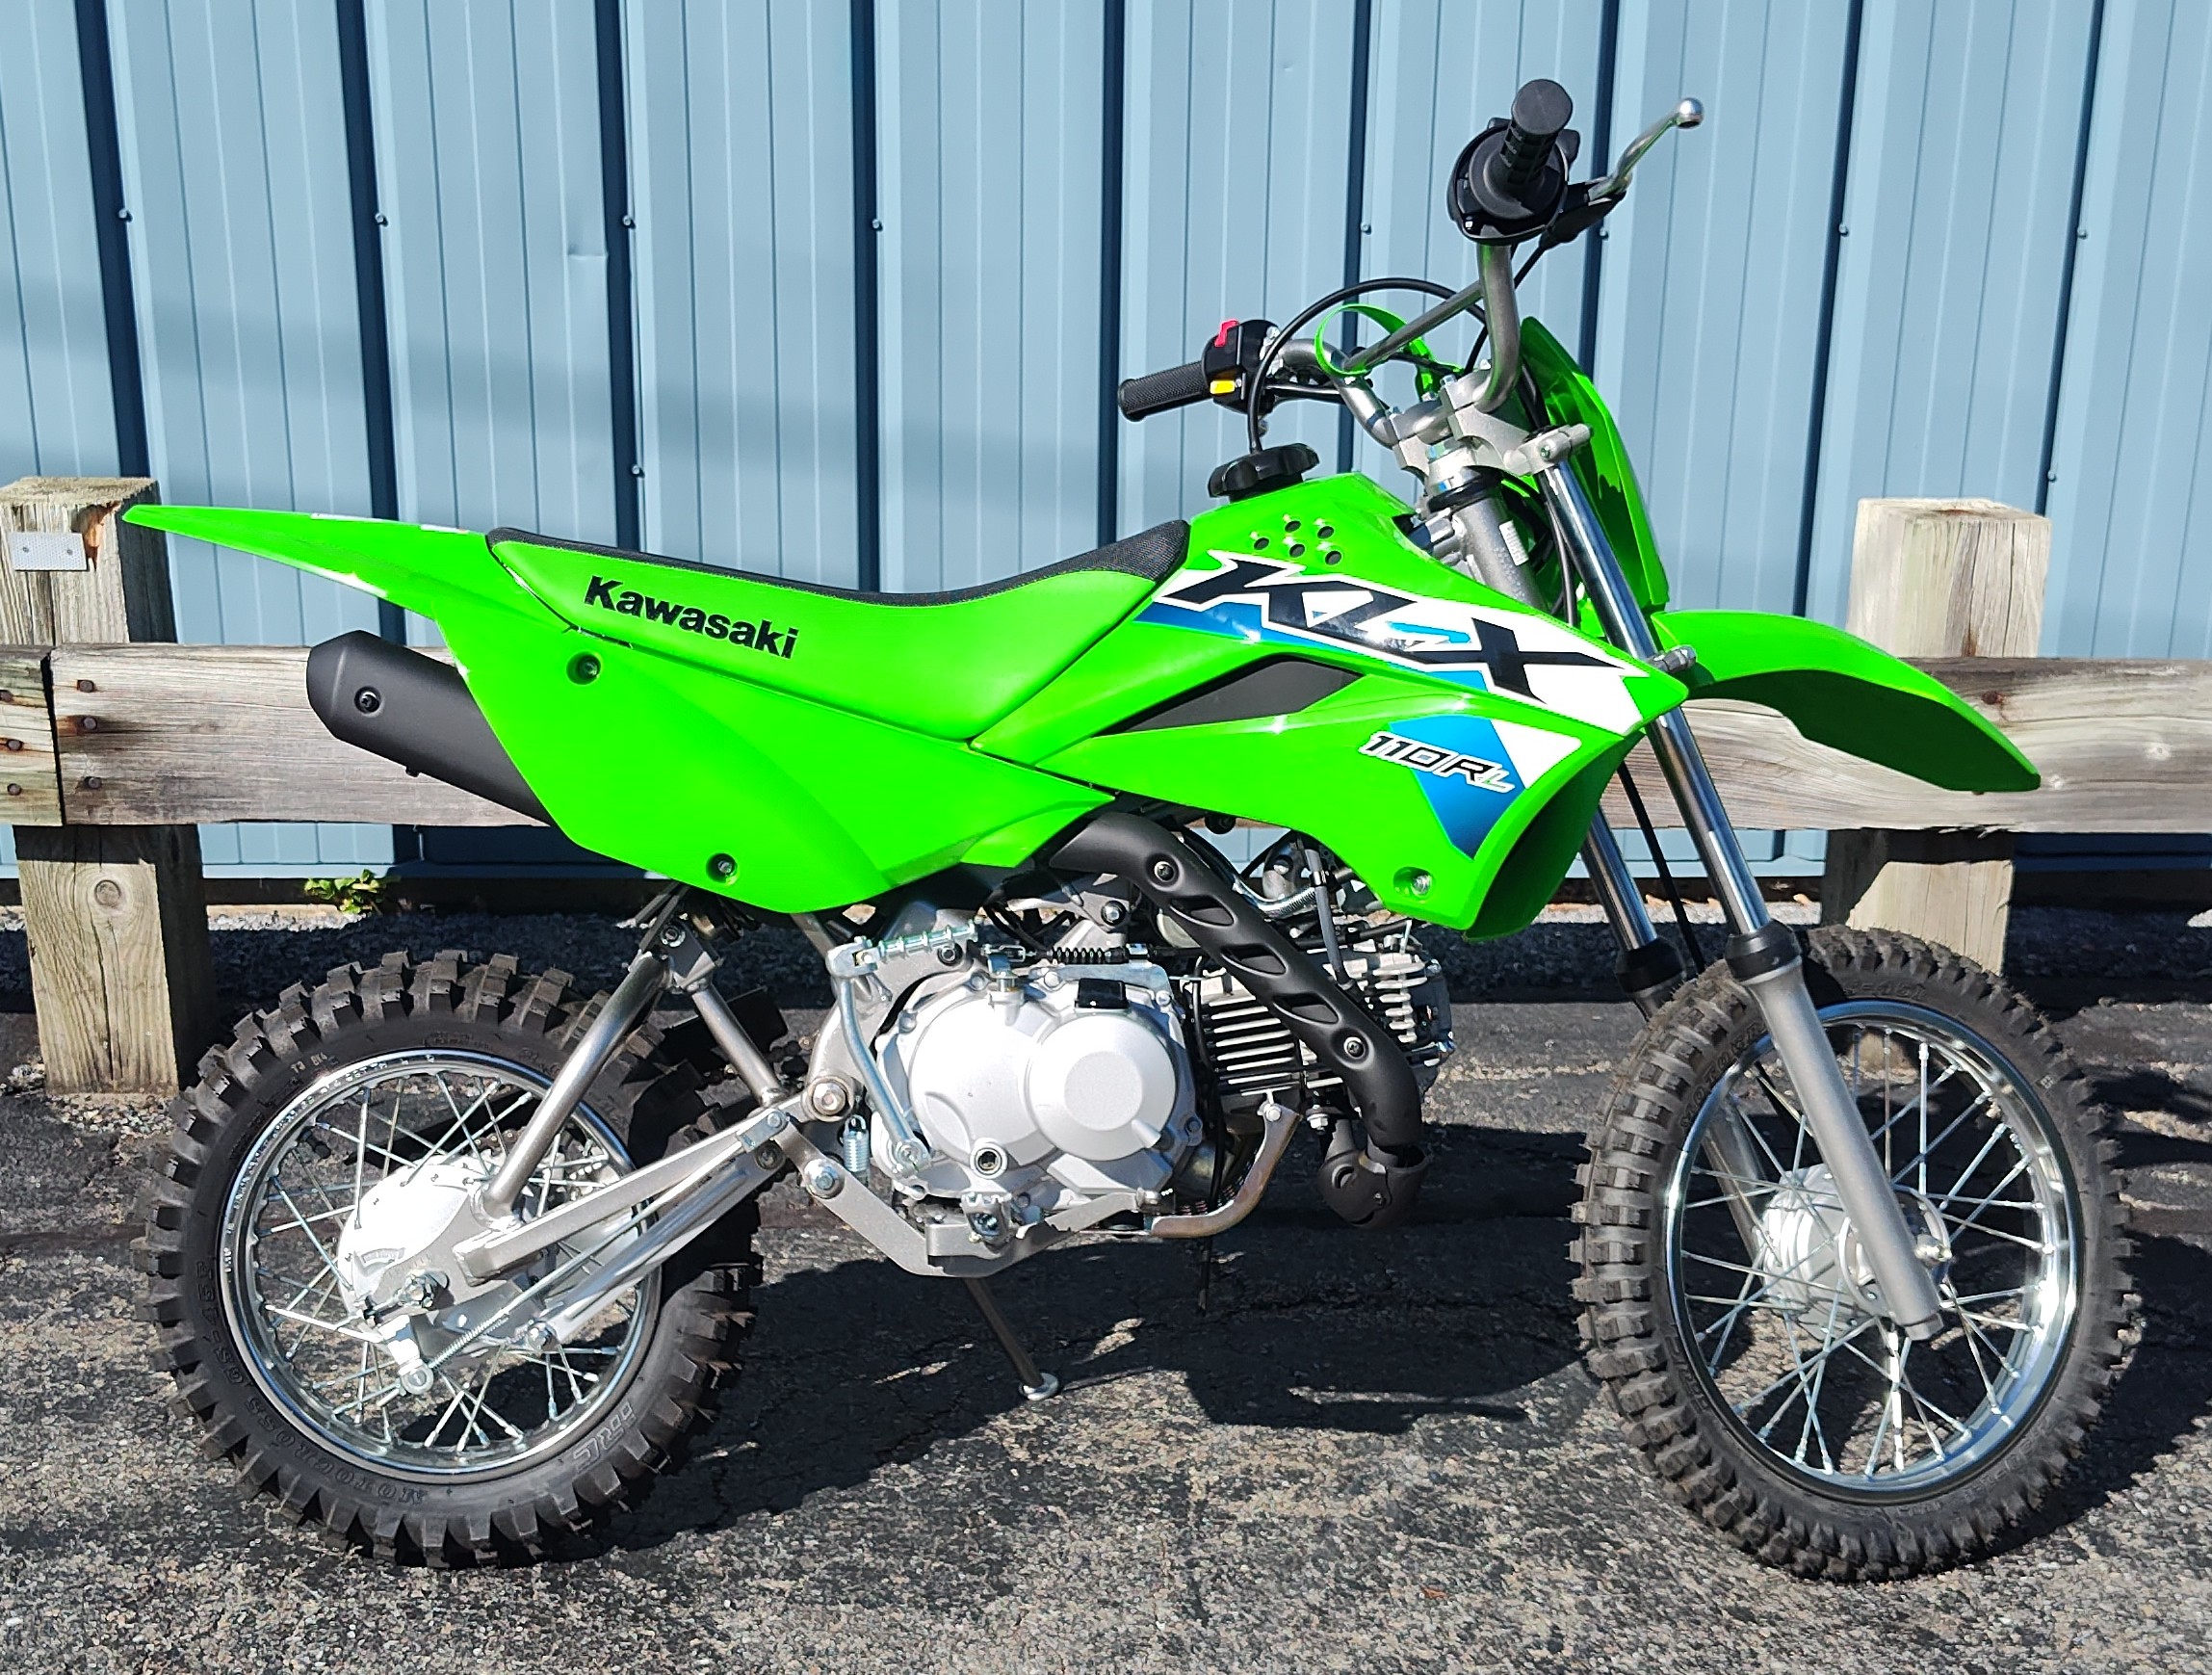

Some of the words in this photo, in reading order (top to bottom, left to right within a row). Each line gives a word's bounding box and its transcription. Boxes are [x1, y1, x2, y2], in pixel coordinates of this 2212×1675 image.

[584, 576, 798, 659] Kawasaki
[1163, 558, 1627, 705] KLX
[244, 1397, 427, 1506] MOTOCROSS
